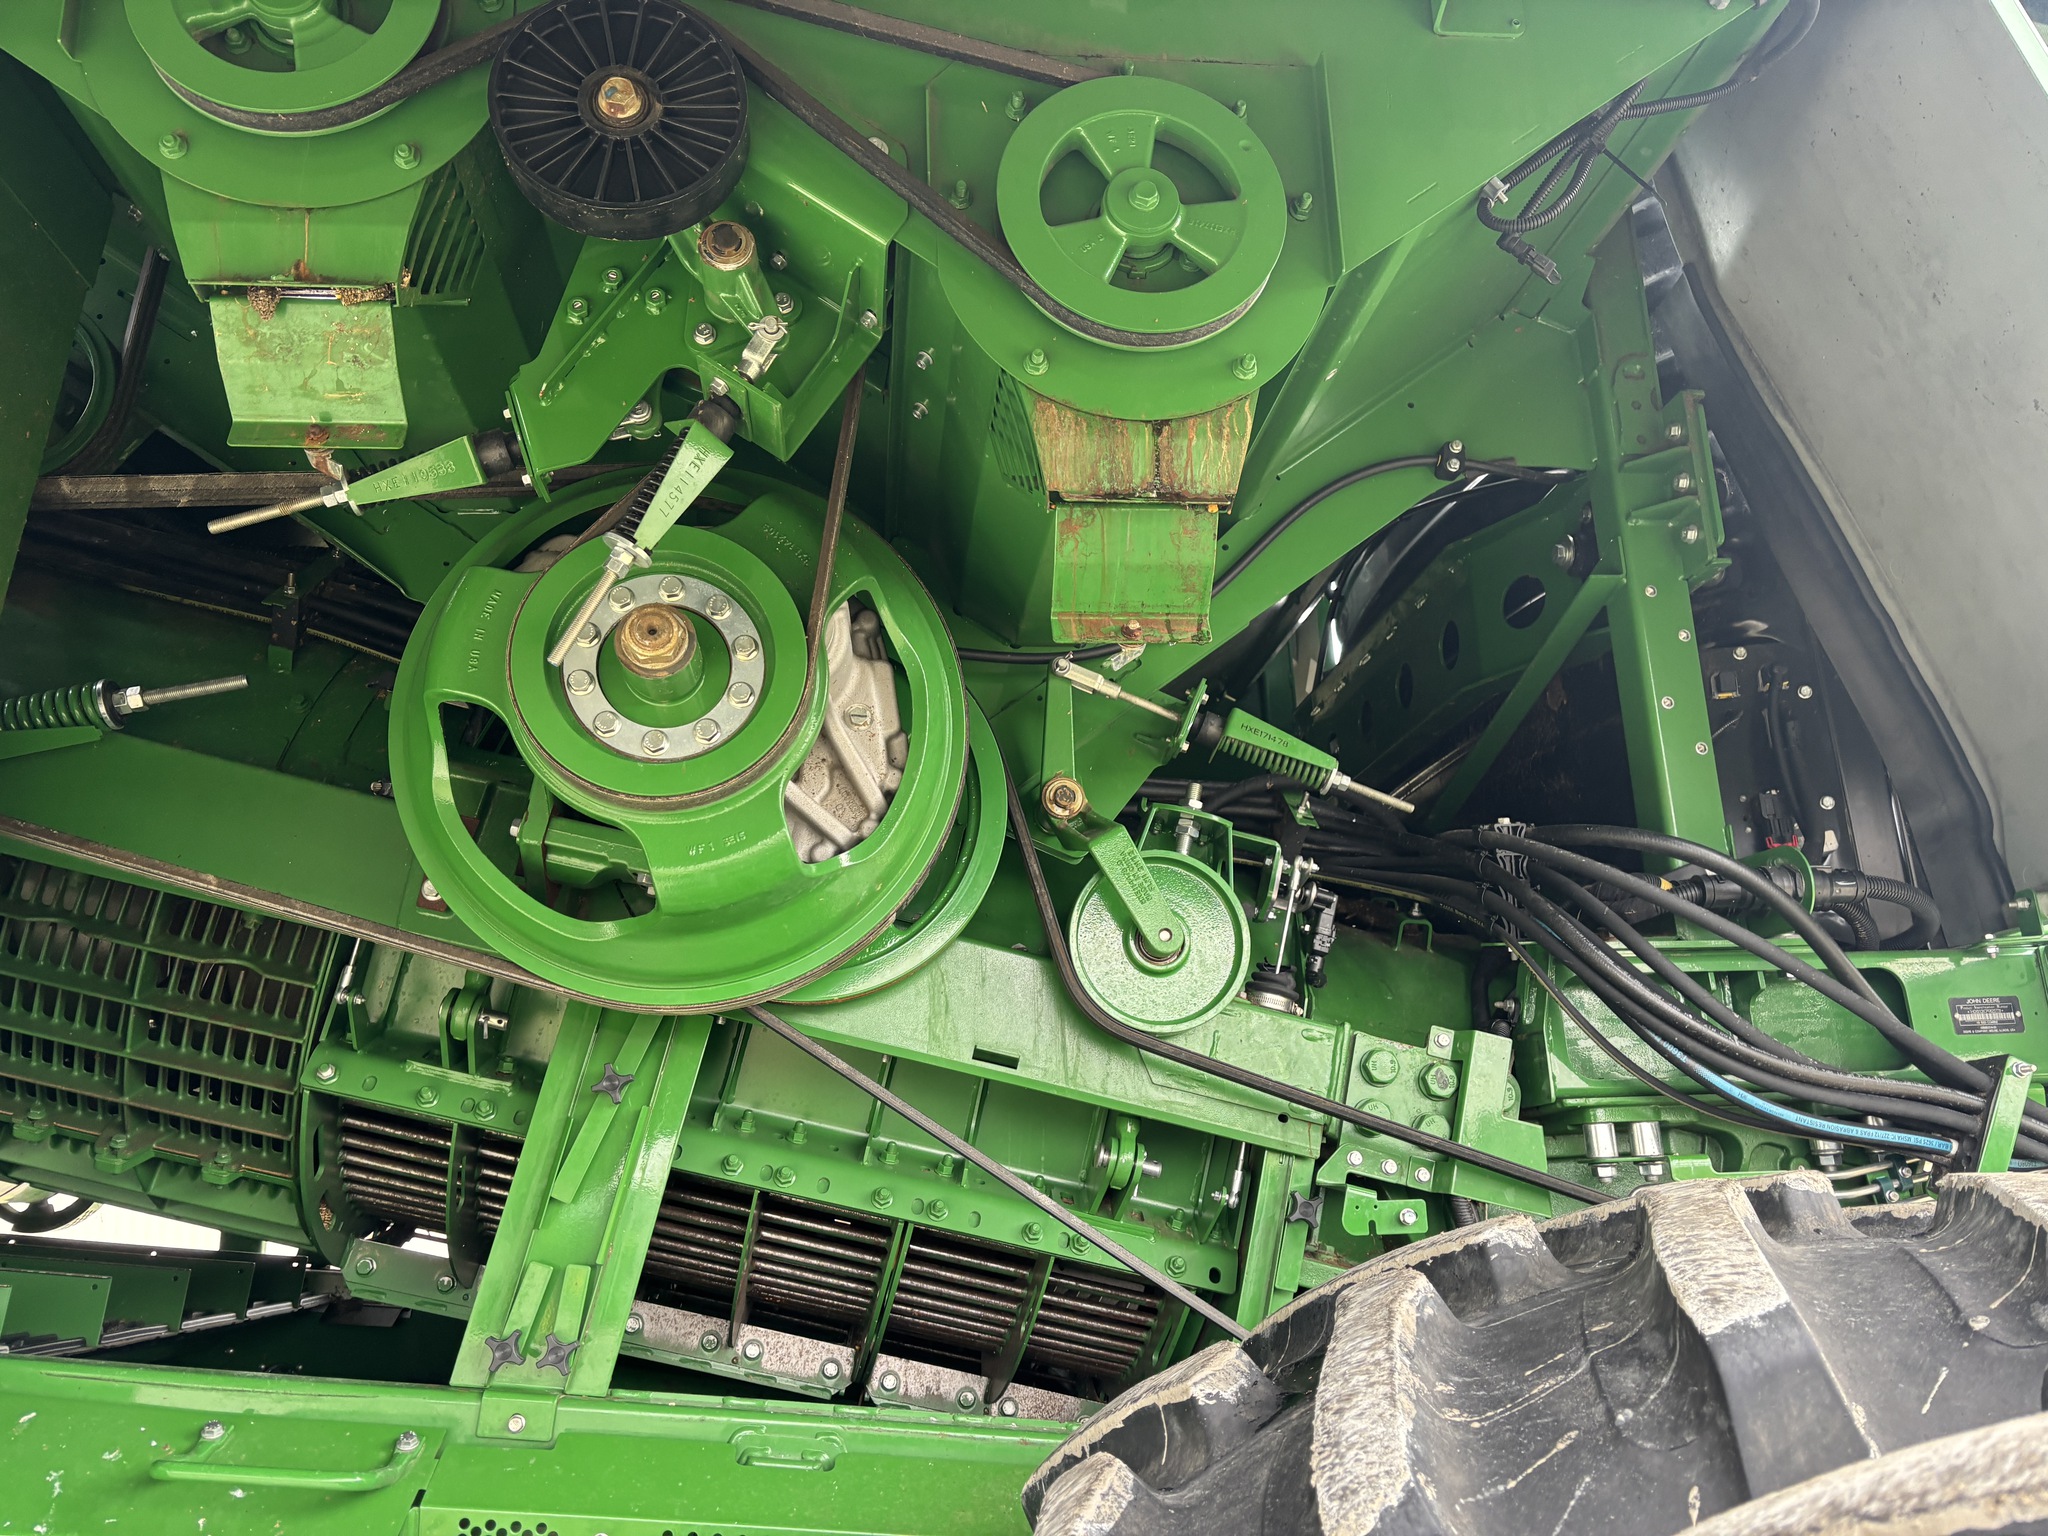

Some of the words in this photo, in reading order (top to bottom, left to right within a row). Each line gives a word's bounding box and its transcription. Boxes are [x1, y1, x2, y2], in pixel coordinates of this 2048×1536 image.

[659, 446, 711, 518] HXE114577
[1240, 722, 1289, 748] HXE171478
[1663, 1042, 1687, 1063] T3600
[1506, 1087, 1515, 1102] 10.9
[1795, 1115, 1826, 1129] RESISTANT
[1826, 1124, 1855, 1134] ABRASION
